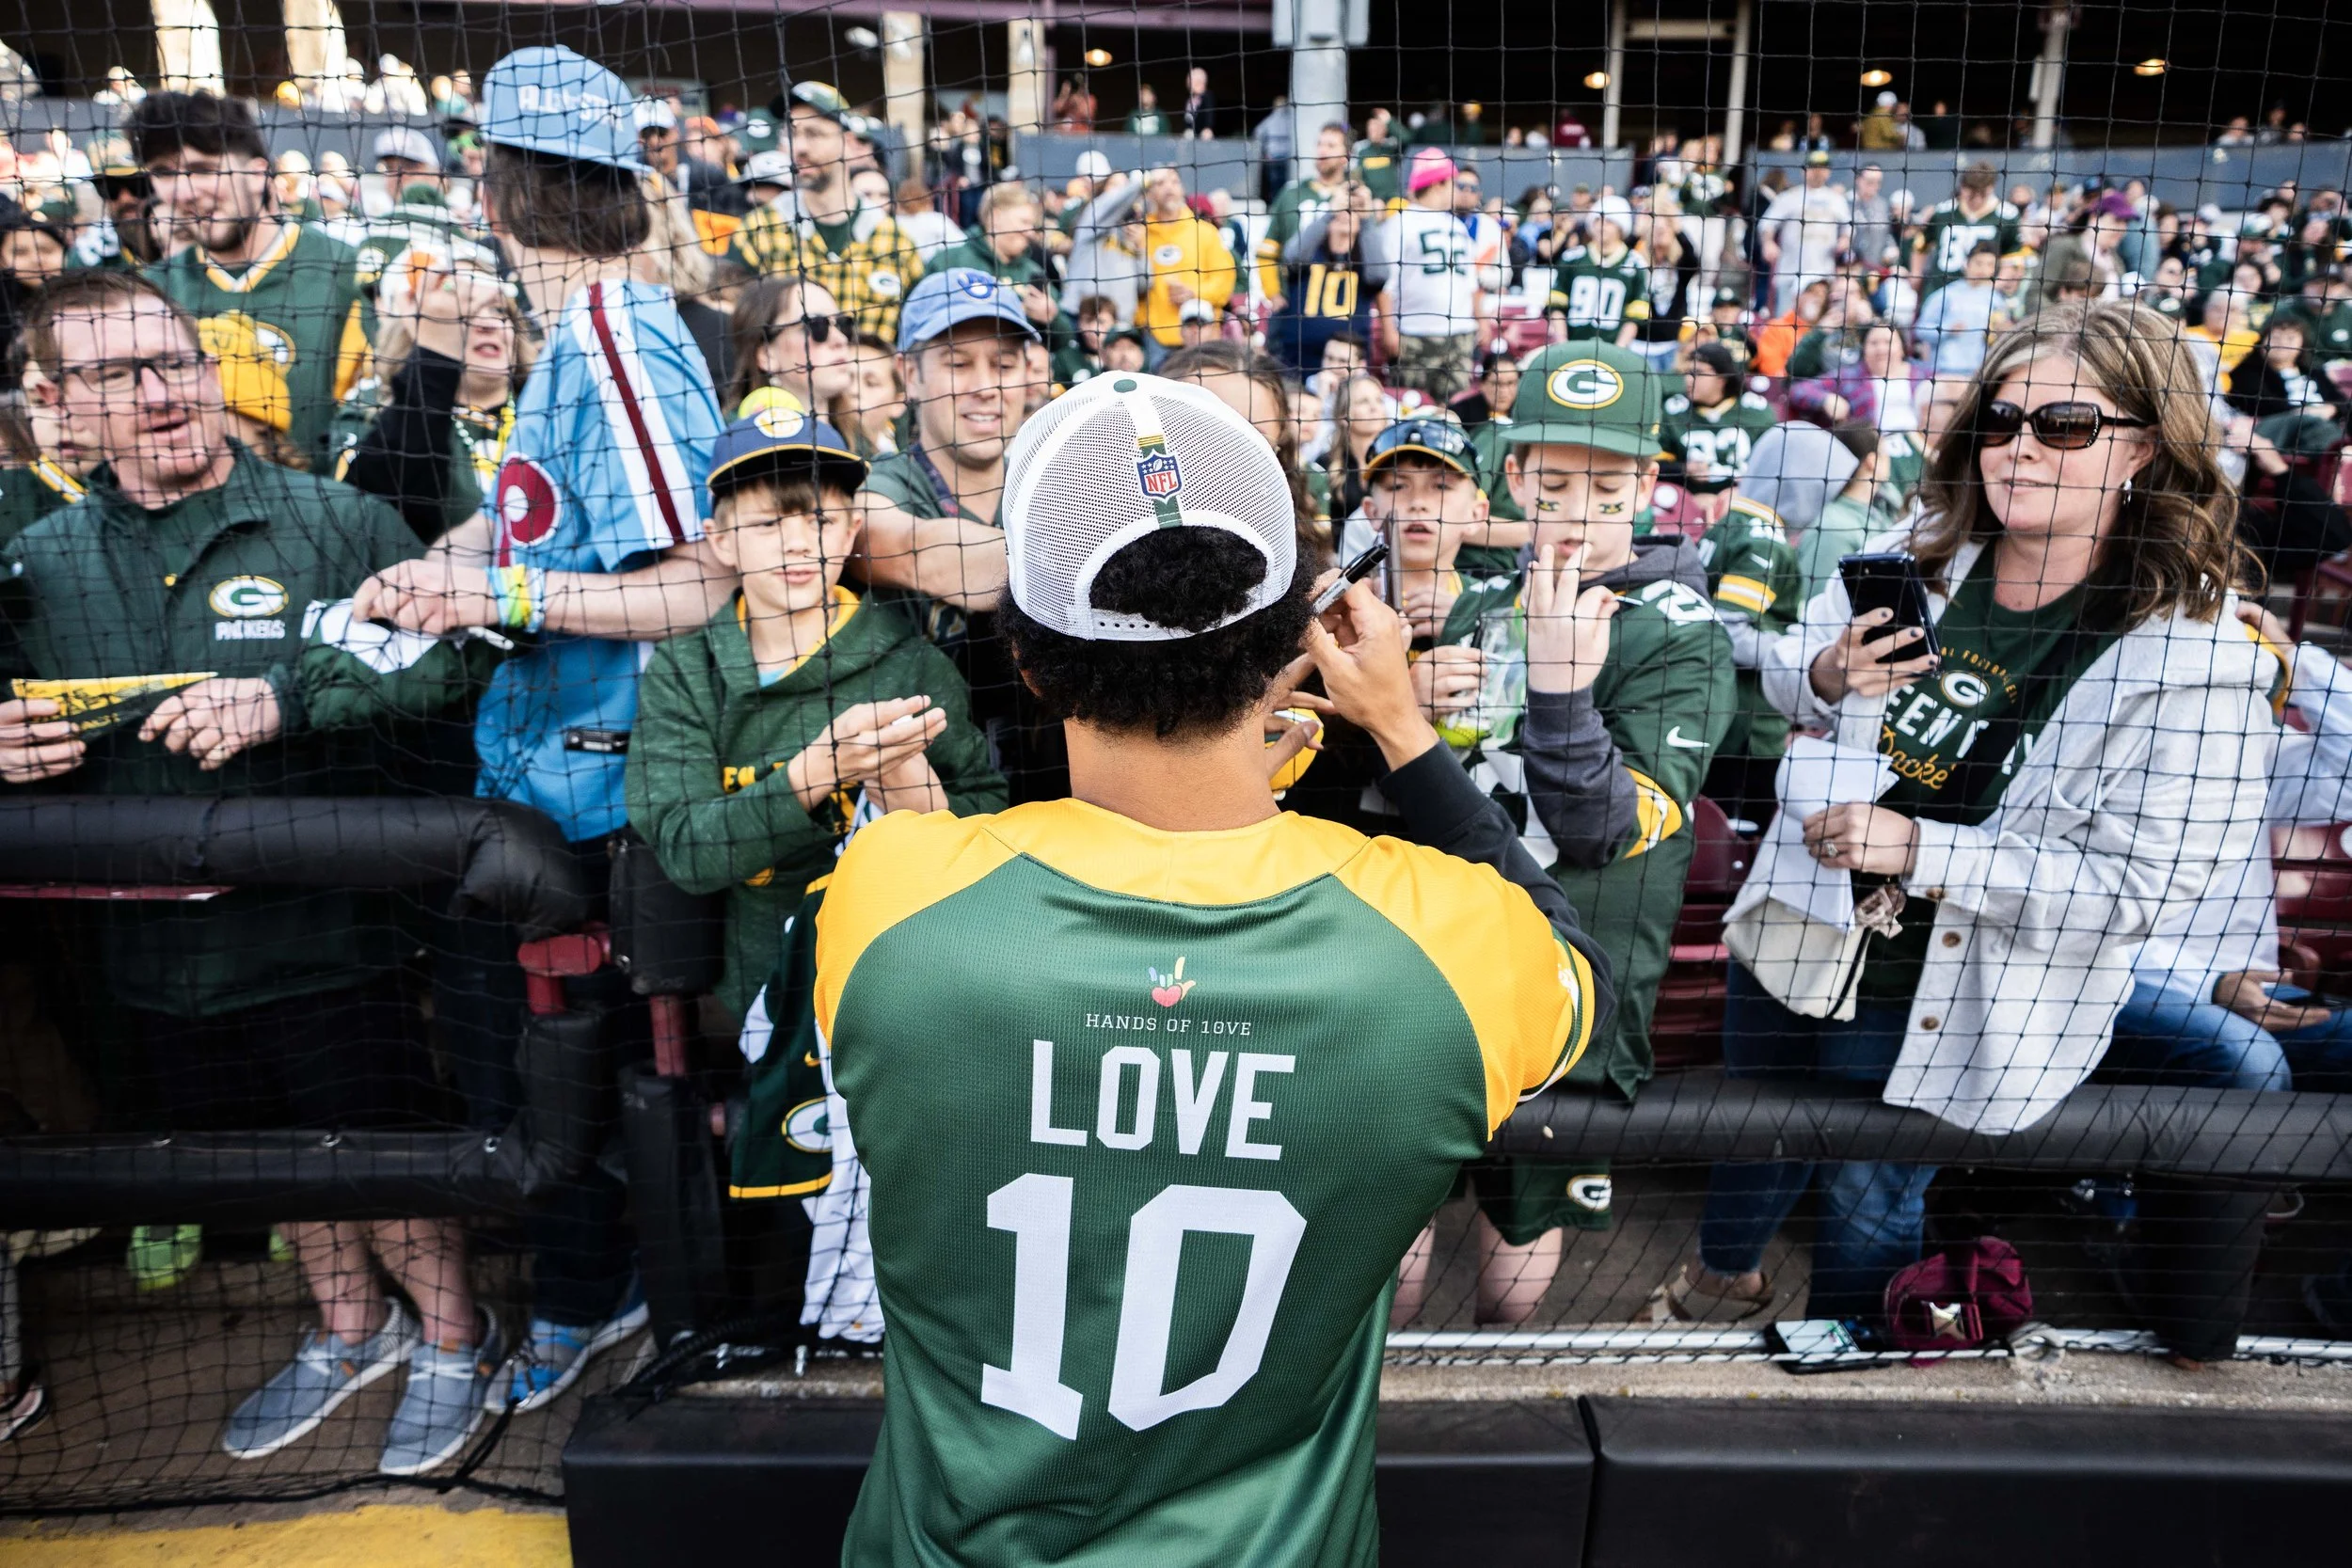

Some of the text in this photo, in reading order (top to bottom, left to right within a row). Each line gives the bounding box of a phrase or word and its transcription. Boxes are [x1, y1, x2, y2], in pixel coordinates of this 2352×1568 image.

[1304, 263, 1359, 321] 10
[1567, 275, 1627, 330] 90
[1552, 364, 1618, 404] G
[1145, 471, 1178, 494] NFL
[214, 578, 284, 616] G
[1944, 672, 1989, 706] G
[1085, 1013, 1157, 1031] HANDS
[1167, 1019, 1191, 1033] OF
[1030, 1039, 1295, 1160] LOVE
[980, 1172, 1308, 1441] 10
